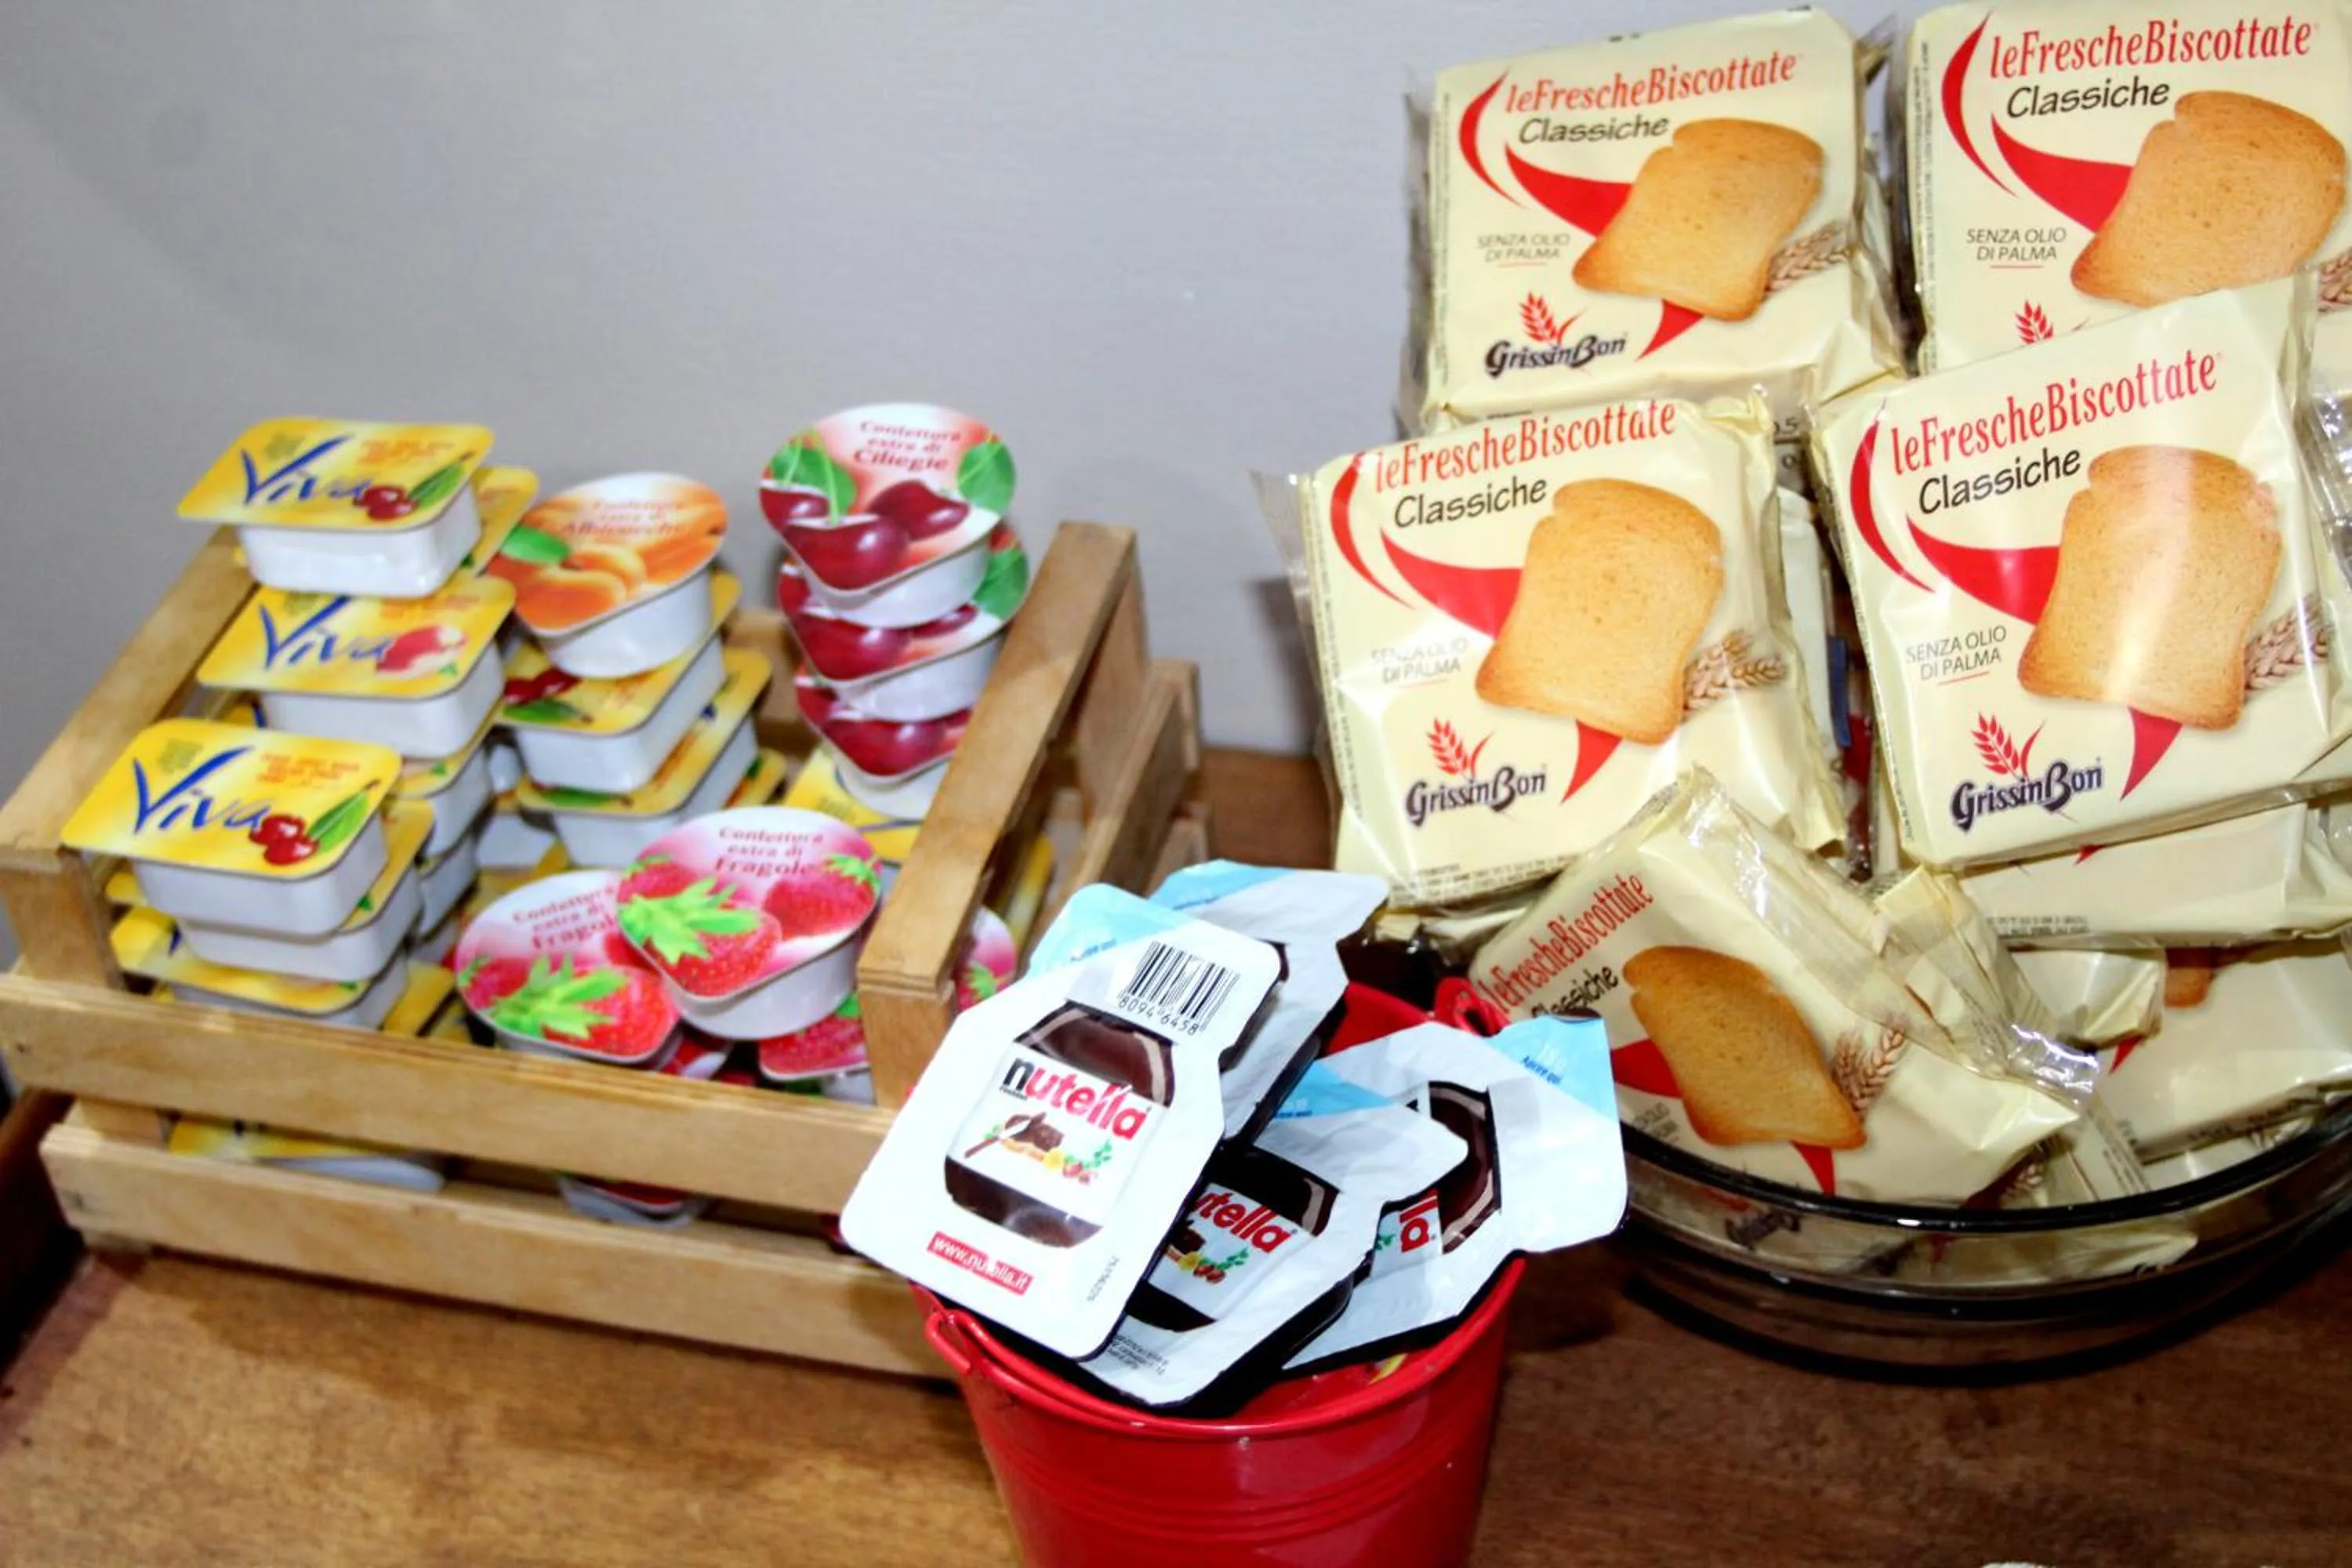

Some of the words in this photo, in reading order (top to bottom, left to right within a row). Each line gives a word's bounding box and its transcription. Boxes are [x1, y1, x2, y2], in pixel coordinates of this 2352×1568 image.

[1990, 16, 2313, 78] leFrescheBiscottate
[1504, 51, 1797, 114] leFrescheBiscottate
[2007, 76, 2170, 118] Classiche
[1519, 114, 1669, 144] Classiche
[1966, 229, 2021, 244] SENZA
[2024, 227, 2067, 243] OLIO
[1976, 247, 1995, 262] DI
[1998, 245, 2057, 261] PALMA
[1485, 333, 1626, 379] GrissinBon
[1891, 350, 2217, 476] leFrescheBiscottate
[1374, 399, 1677, 494] leFrescheBiscottate
[1395, 476, 1547, 529] Classiche
[1919, 448, 2082, 515] Classiche
[1905, 637, 1962, 664] SENZA
[1965, 625, 2007, 649] OLIO
[1920, 660, 1938, 681] DI
[1942, 647, 2002, 676] PALMA
[132, 744, 276, 835] Viva
[1406, 765, 1547, 826] GrissinBon
[1951, 757, 2103, 834] GrissinBon
[532, 913, 615, 950] Fragol
[1002, 1057, 1148, 1141] nutella
[1196, 1191, 1292, 1254] tella
[932, 1236, 1030, 1290] www.nulla.it
